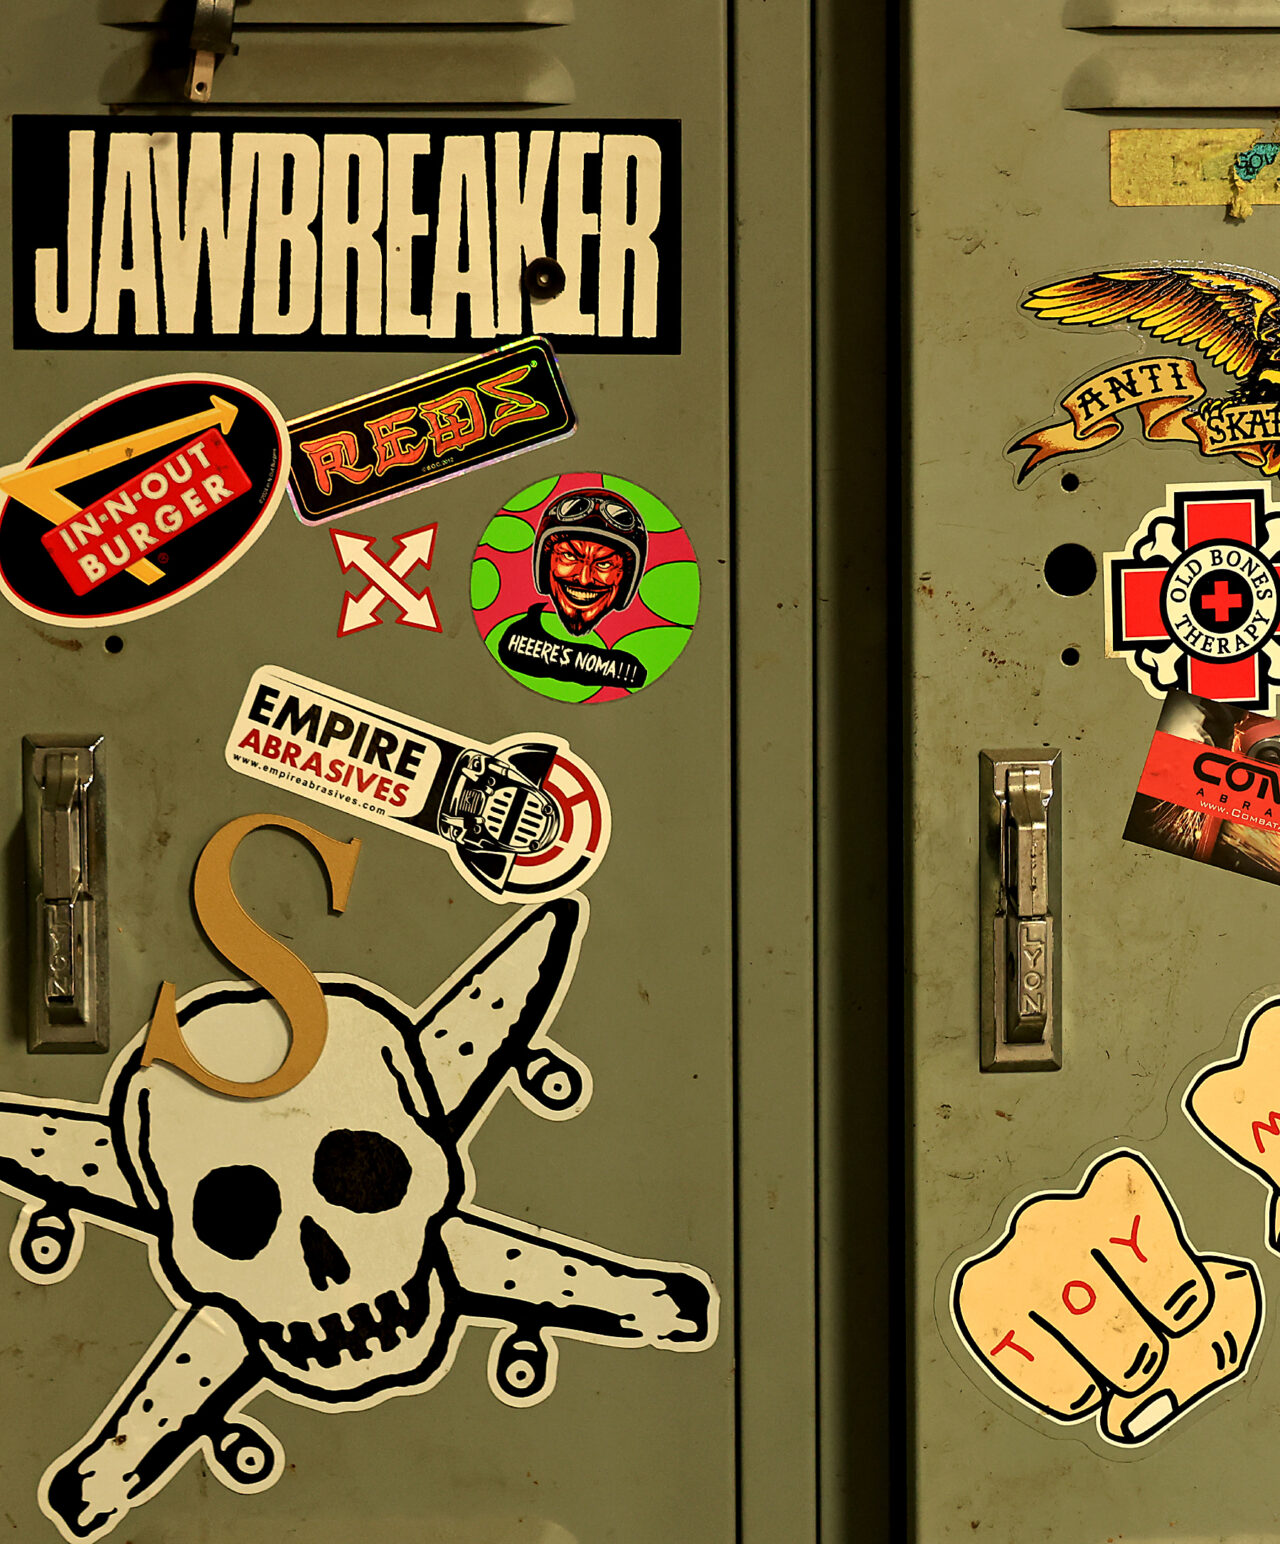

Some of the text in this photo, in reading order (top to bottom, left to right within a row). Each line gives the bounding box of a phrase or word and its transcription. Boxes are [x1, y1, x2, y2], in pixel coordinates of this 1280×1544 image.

[35, 129, 662, 338] JAWBREAKER
[299, 364, 549, 496] REDS
[1078, 361, 1189, 422] ANTI
[77, 474, 235, 583] BURGER
[1170, 549, 1273, 603] OLD BONES
[508, 634, 638, 683] HEEERE'S NOMA!!!
[1174, 609, 1270, 654] THERAPY
[238, 728, 410, 807] ABRASIVES
[248, 684, 427, 780] EMPIRE
[233, 753, 386, 816] www.empireabrasives.com
[141, 813, 362, 1100] S
[1021, 926, 1045, 1013] LYON
[989, 1214, 1148, 1362] TOY
